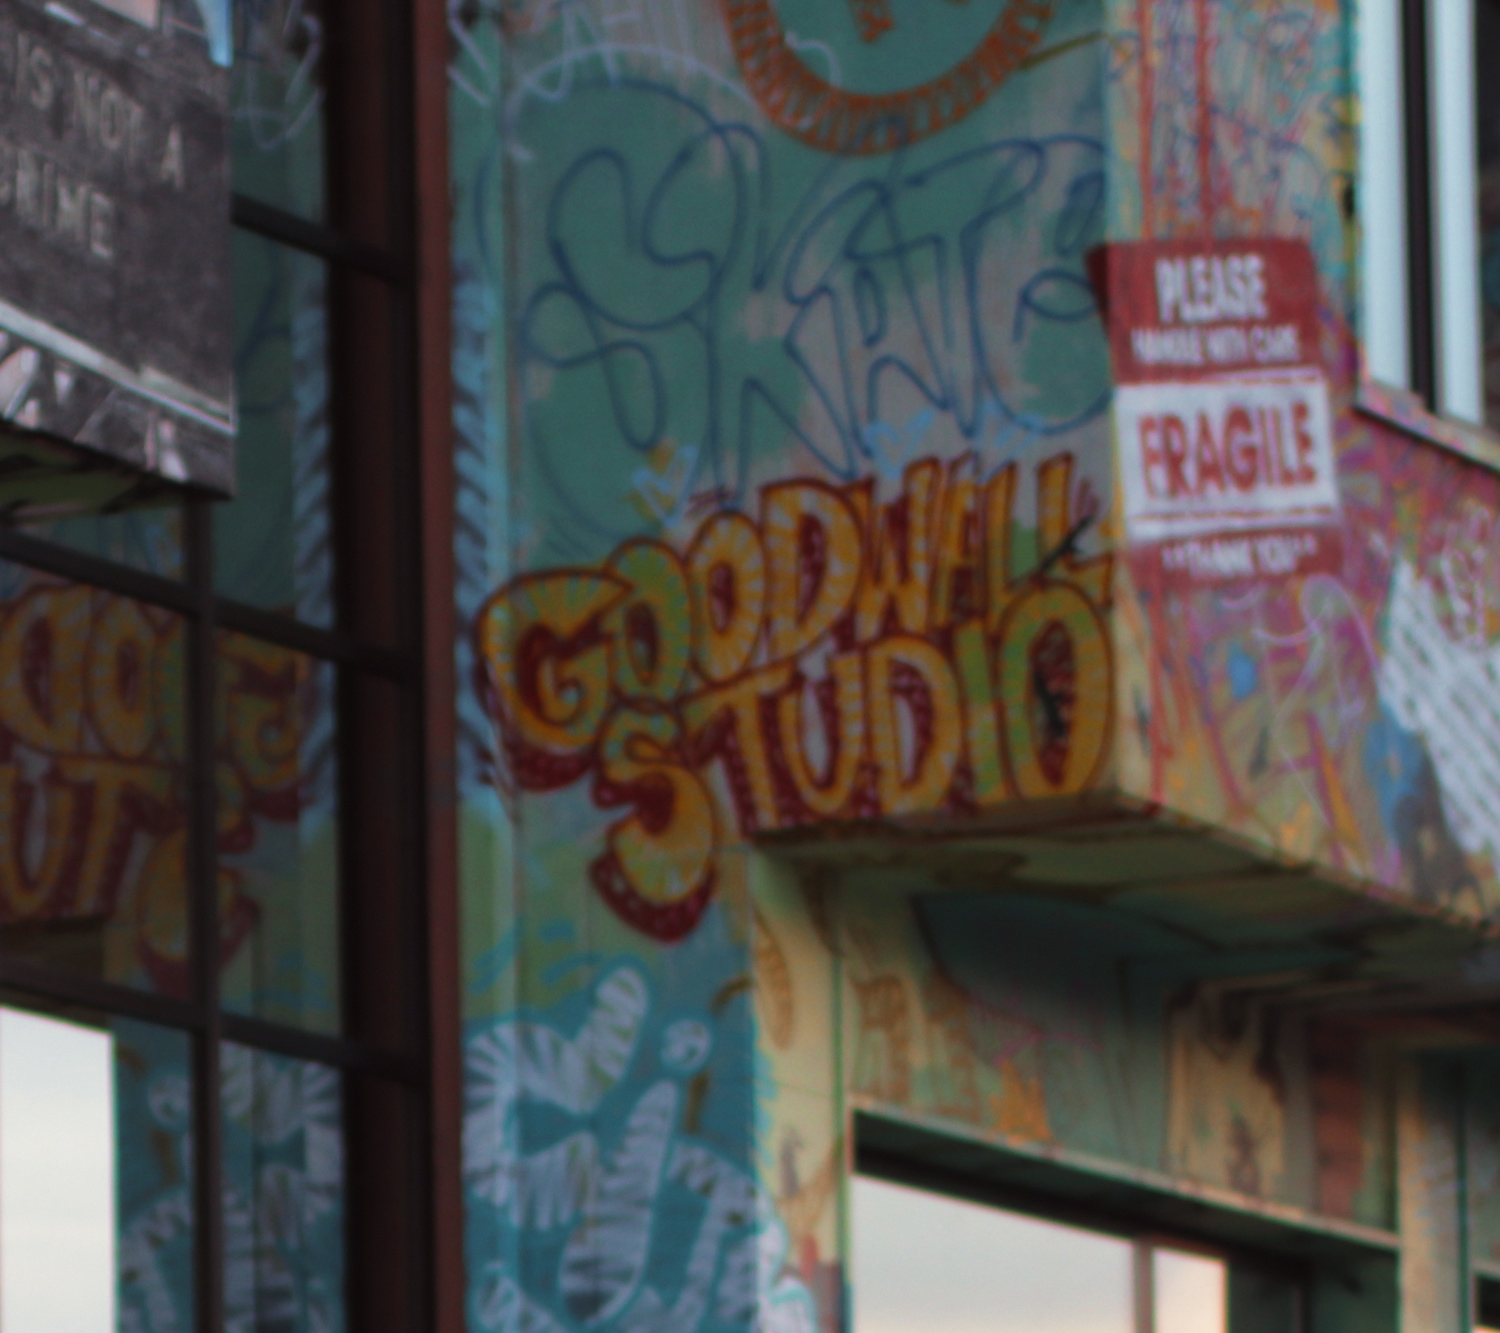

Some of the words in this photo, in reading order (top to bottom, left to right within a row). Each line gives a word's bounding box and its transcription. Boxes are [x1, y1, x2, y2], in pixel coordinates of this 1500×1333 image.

[15, 33, 54, 113] IS
[73, 63, 143, 164] NOT
[162, 122, 185, 190] A
[1156, 253, 1267, 322] PLEASE
[1139, 403, 1316, 498] FRAGILE
[594, 582, 1112, 930] STUDIO
